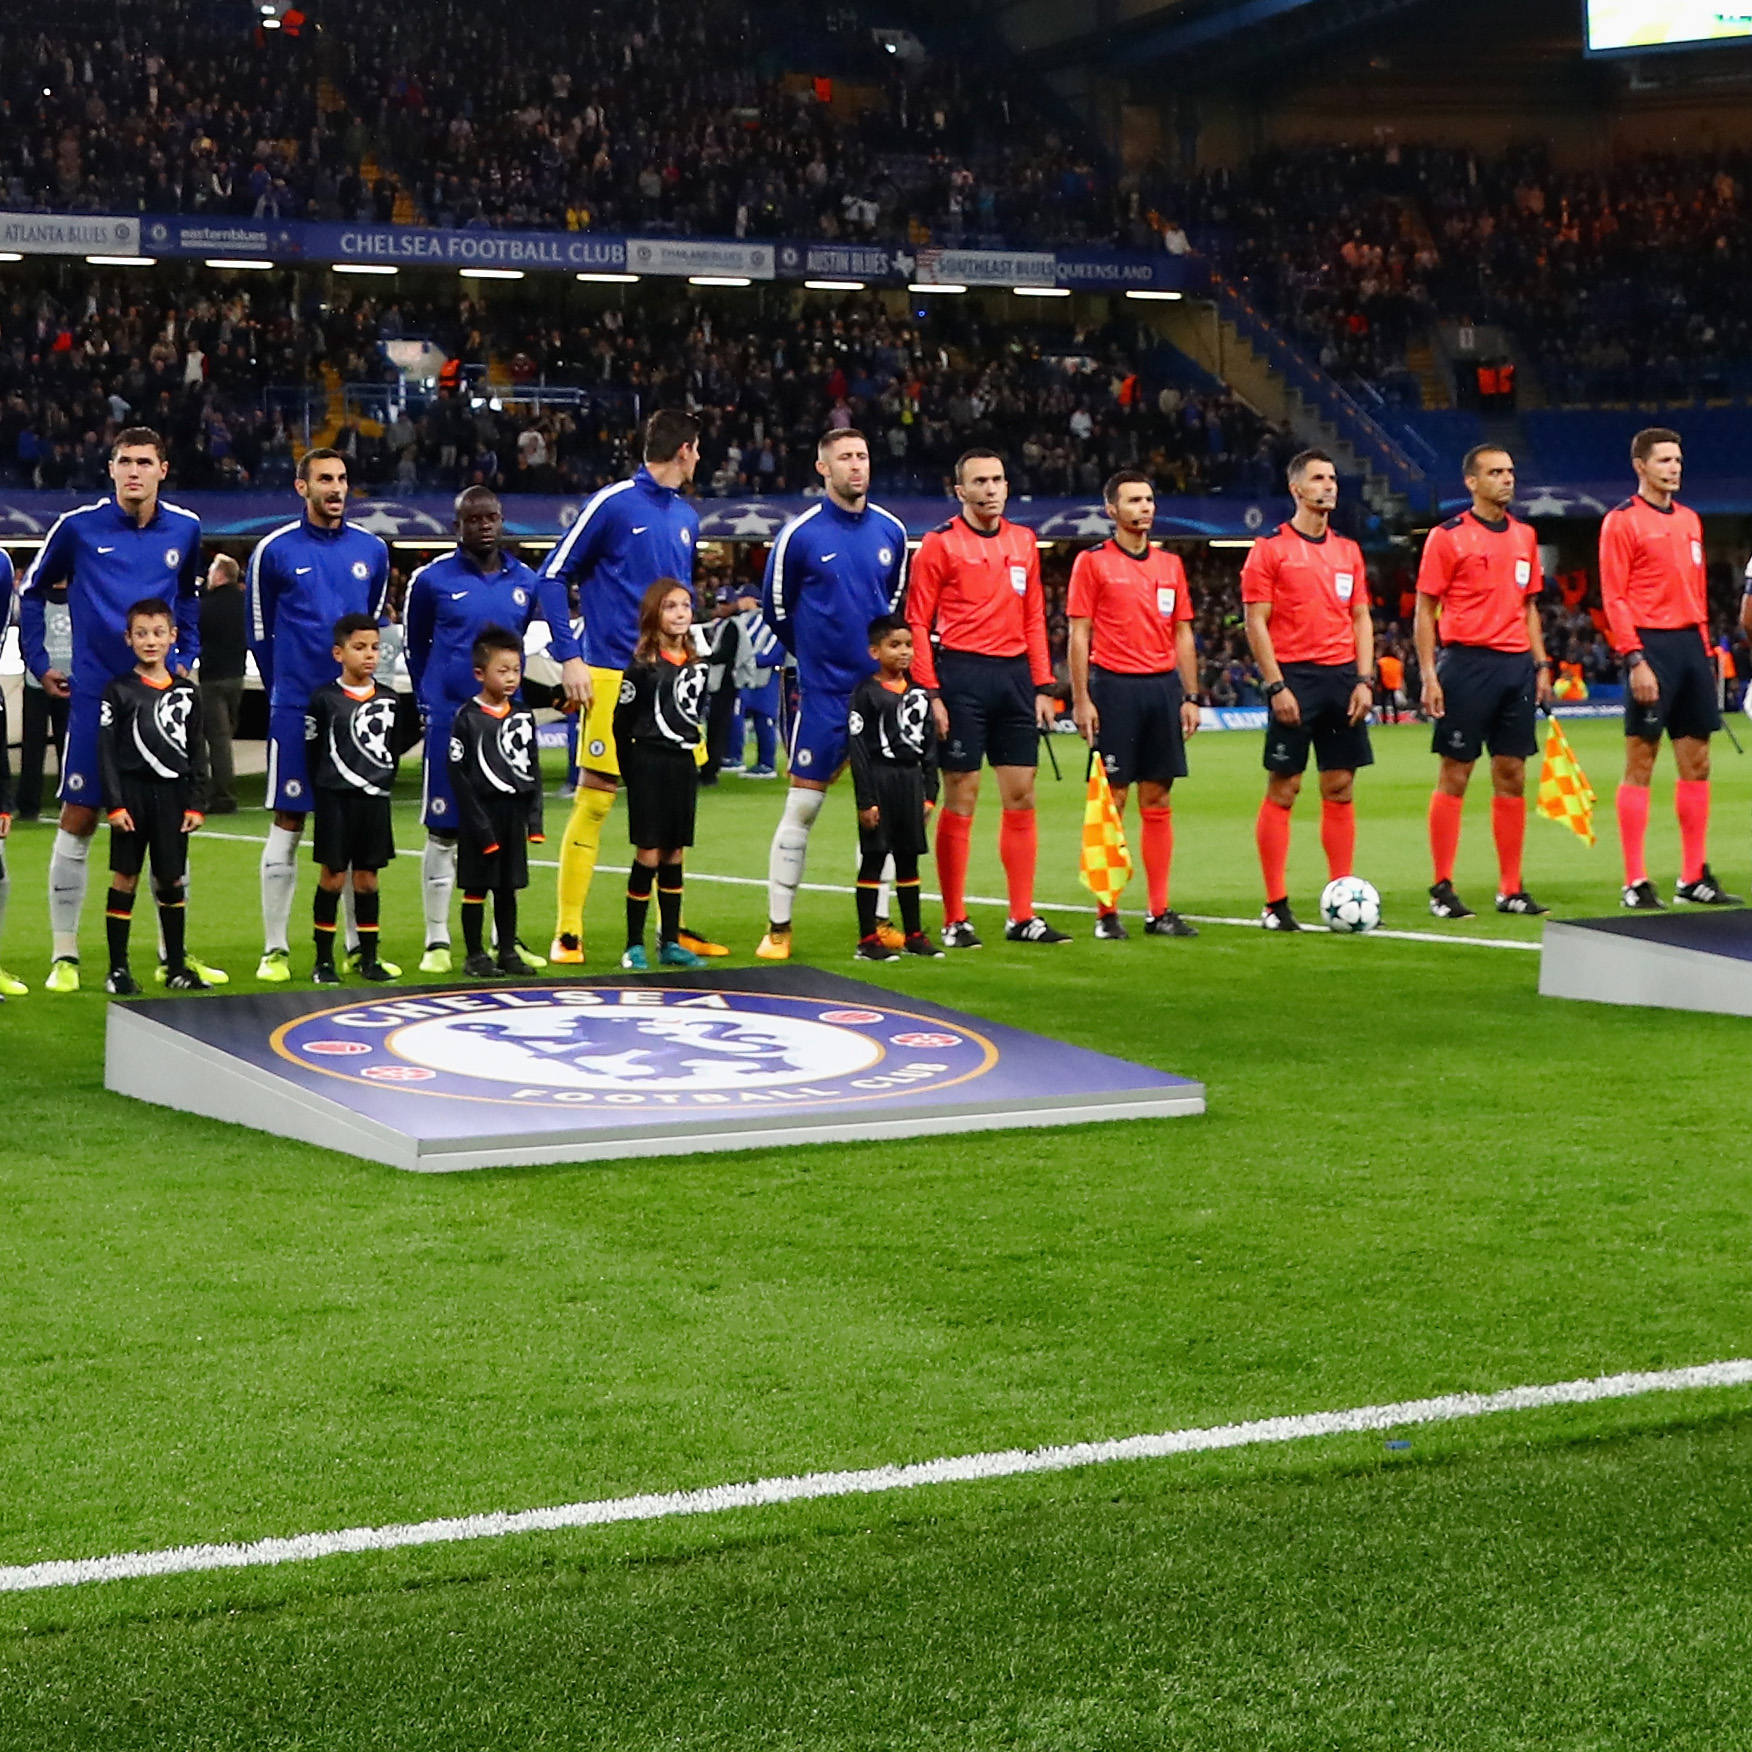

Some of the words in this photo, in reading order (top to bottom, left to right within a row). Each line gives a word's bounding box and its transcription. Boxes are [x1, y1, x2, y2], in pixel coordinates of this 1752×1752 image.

[5, 225, 64, 242] ATLANTA
[68, 226, 109, 243] BLUES
[340, 234, 443, 256] CHELSEA
[448, 238, 563, 261] FOOTBALL
[568, 242, 625, 264] CLUB
[1057, 263, 1153, 281] QUEENSLAND
[332, 988, 729, 1029] CHELSEA
[510, 1084, 840, 1105] FOOTBALL
[850, 1062, 950, 1091] CLUB
